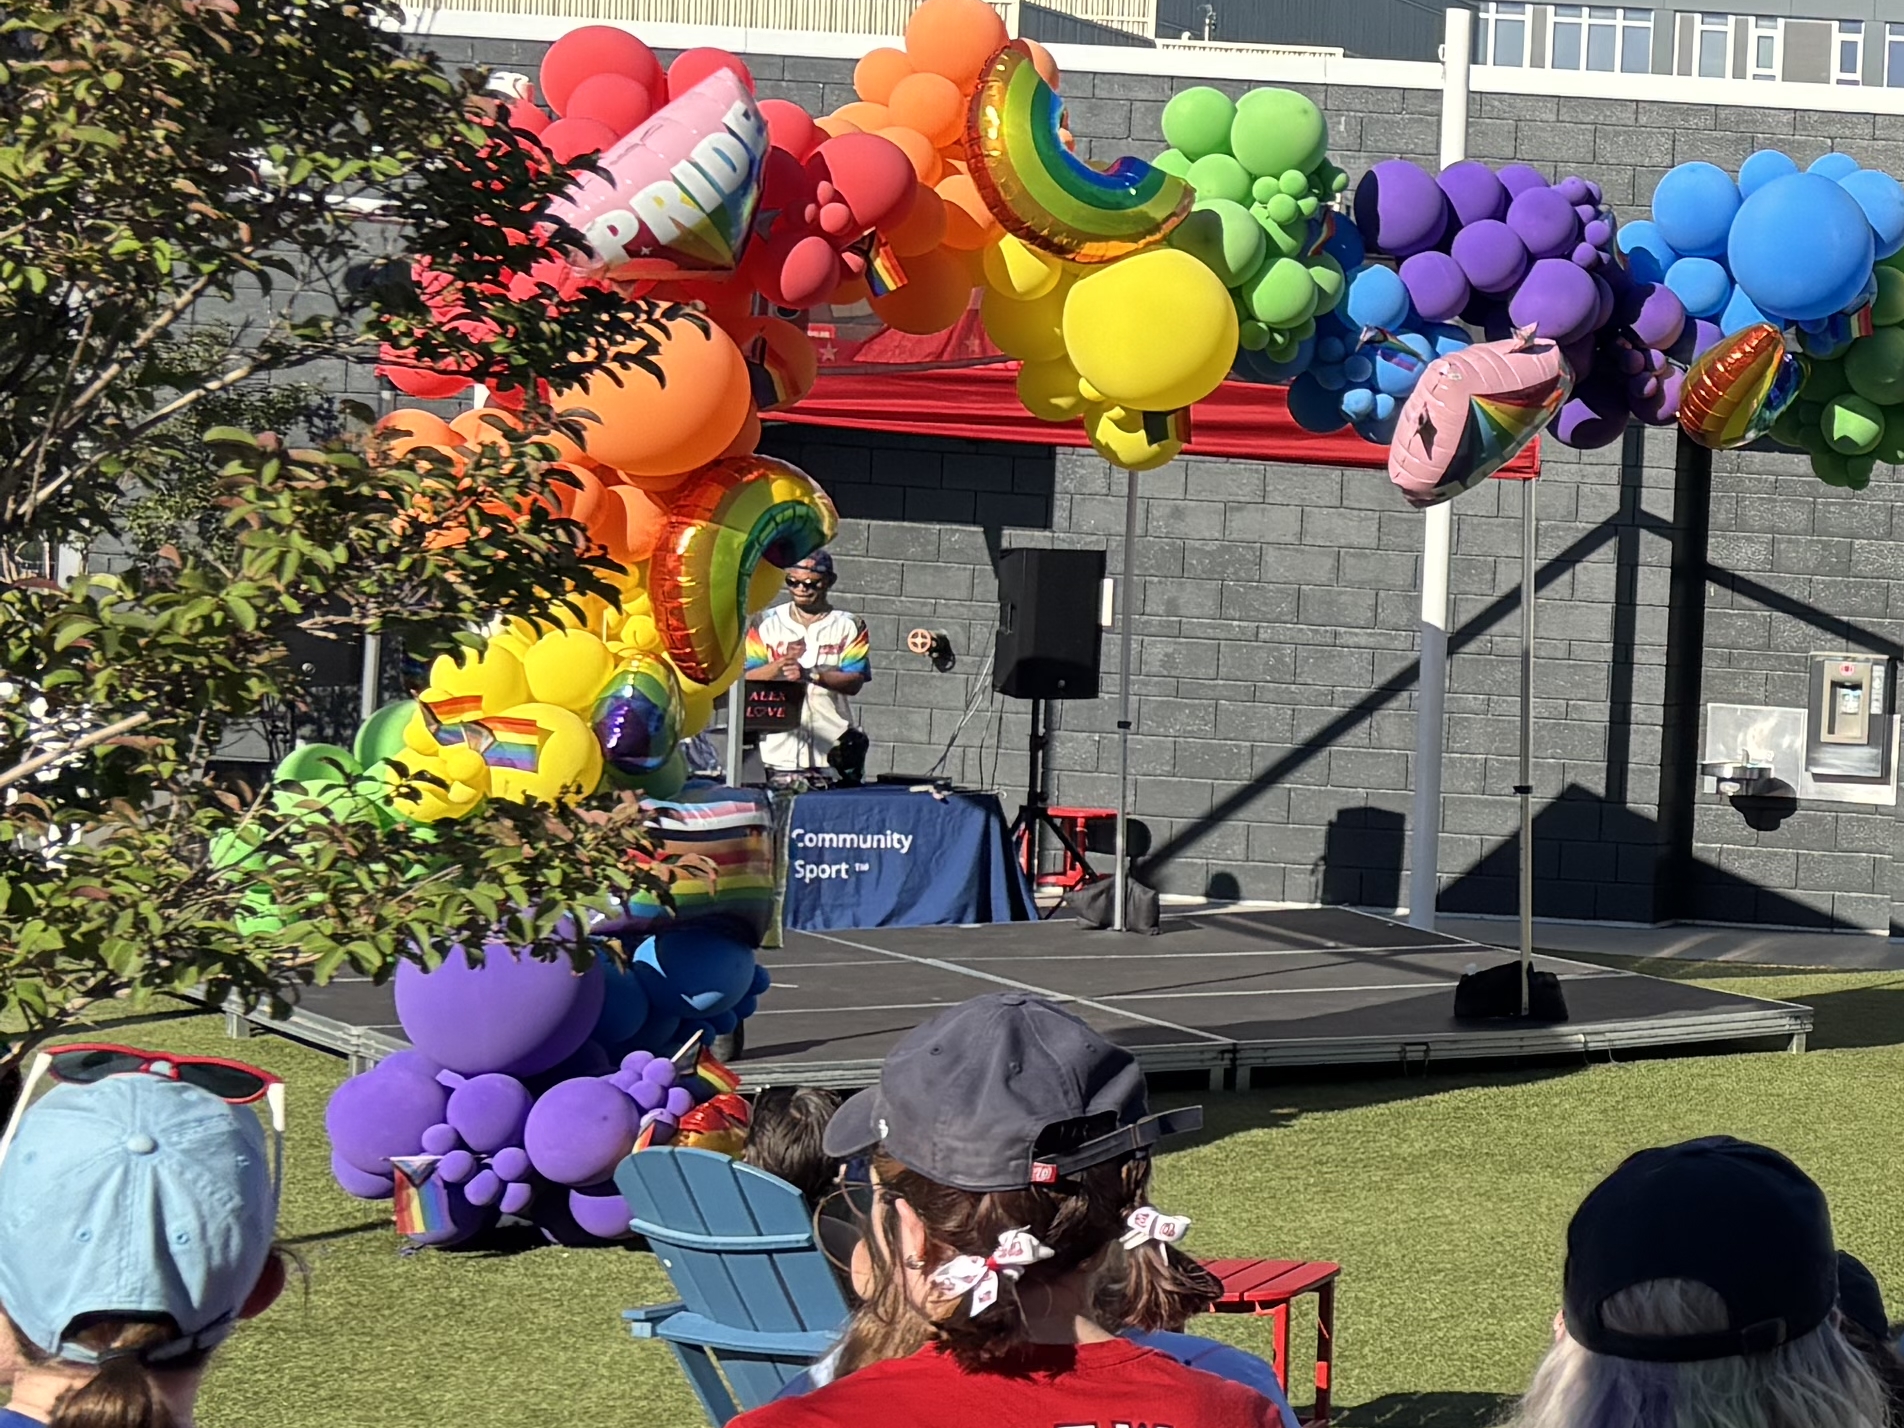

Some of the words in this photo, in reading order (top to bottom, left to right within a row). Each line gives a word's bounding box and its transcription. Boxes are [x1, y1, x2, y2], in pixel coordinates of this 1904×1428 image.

[583, 99, 769, 263] PRIDE
[791, 828, 913, 854] Community
[793, 859, 849, 883] Sport
